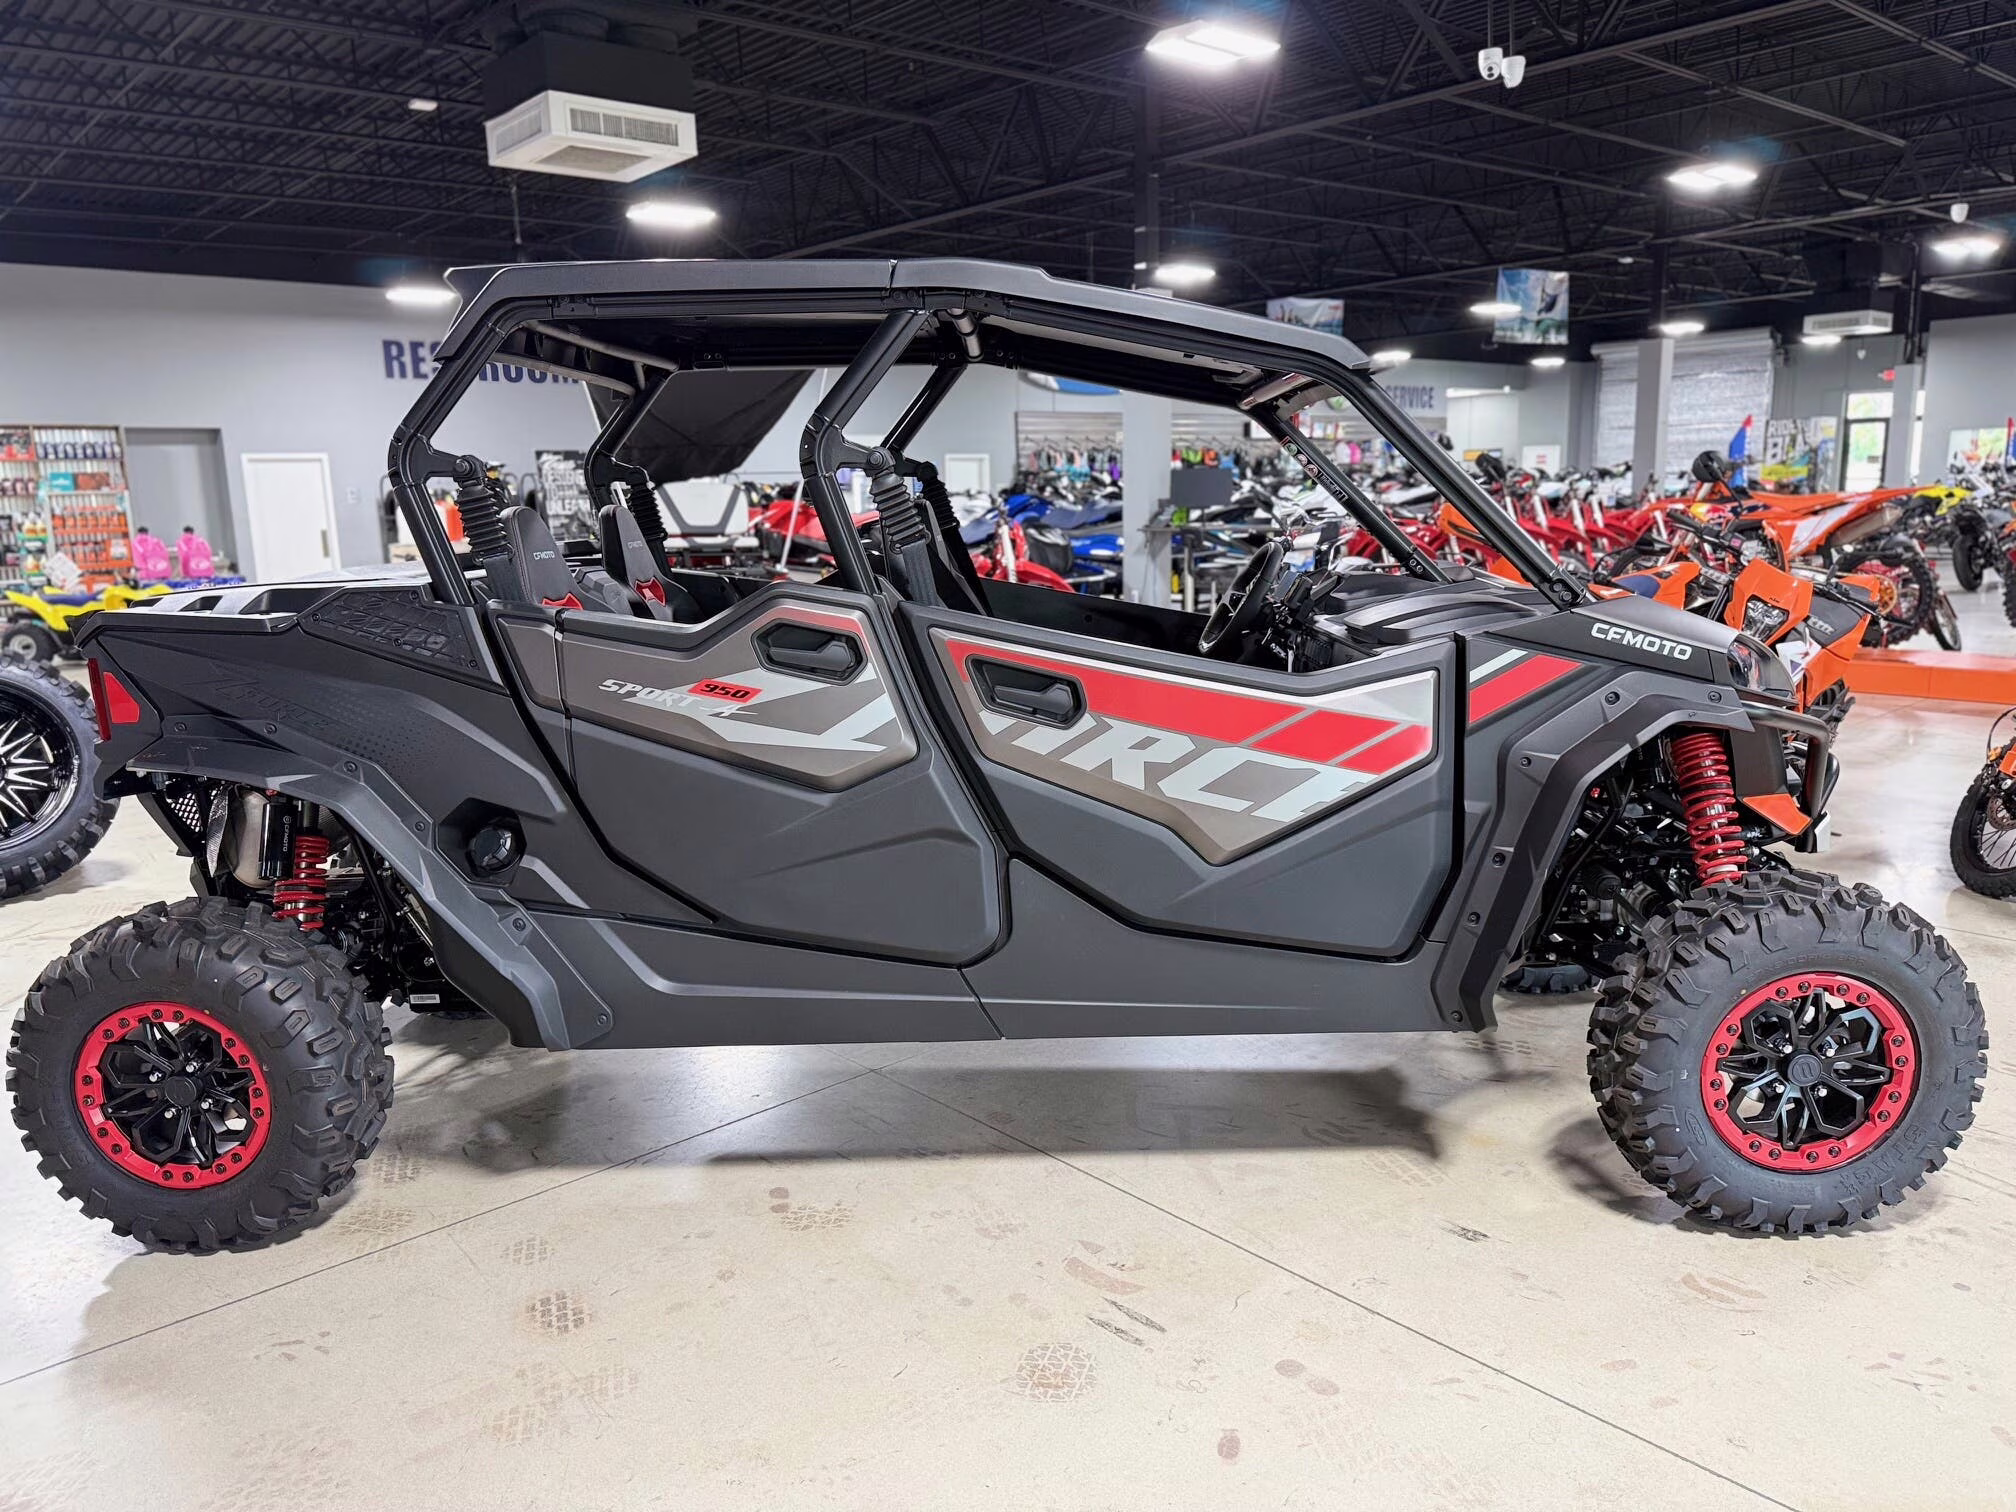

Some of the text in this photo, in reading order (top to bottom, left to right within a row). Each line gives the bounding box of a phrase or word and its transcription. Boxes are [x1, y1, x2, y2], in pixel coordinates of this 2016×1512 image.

[1590, 622, 1693, 662] CFMOTO
[700, 682, 753, 700] 950
[282, 824, 290, 852] CFMOTO
